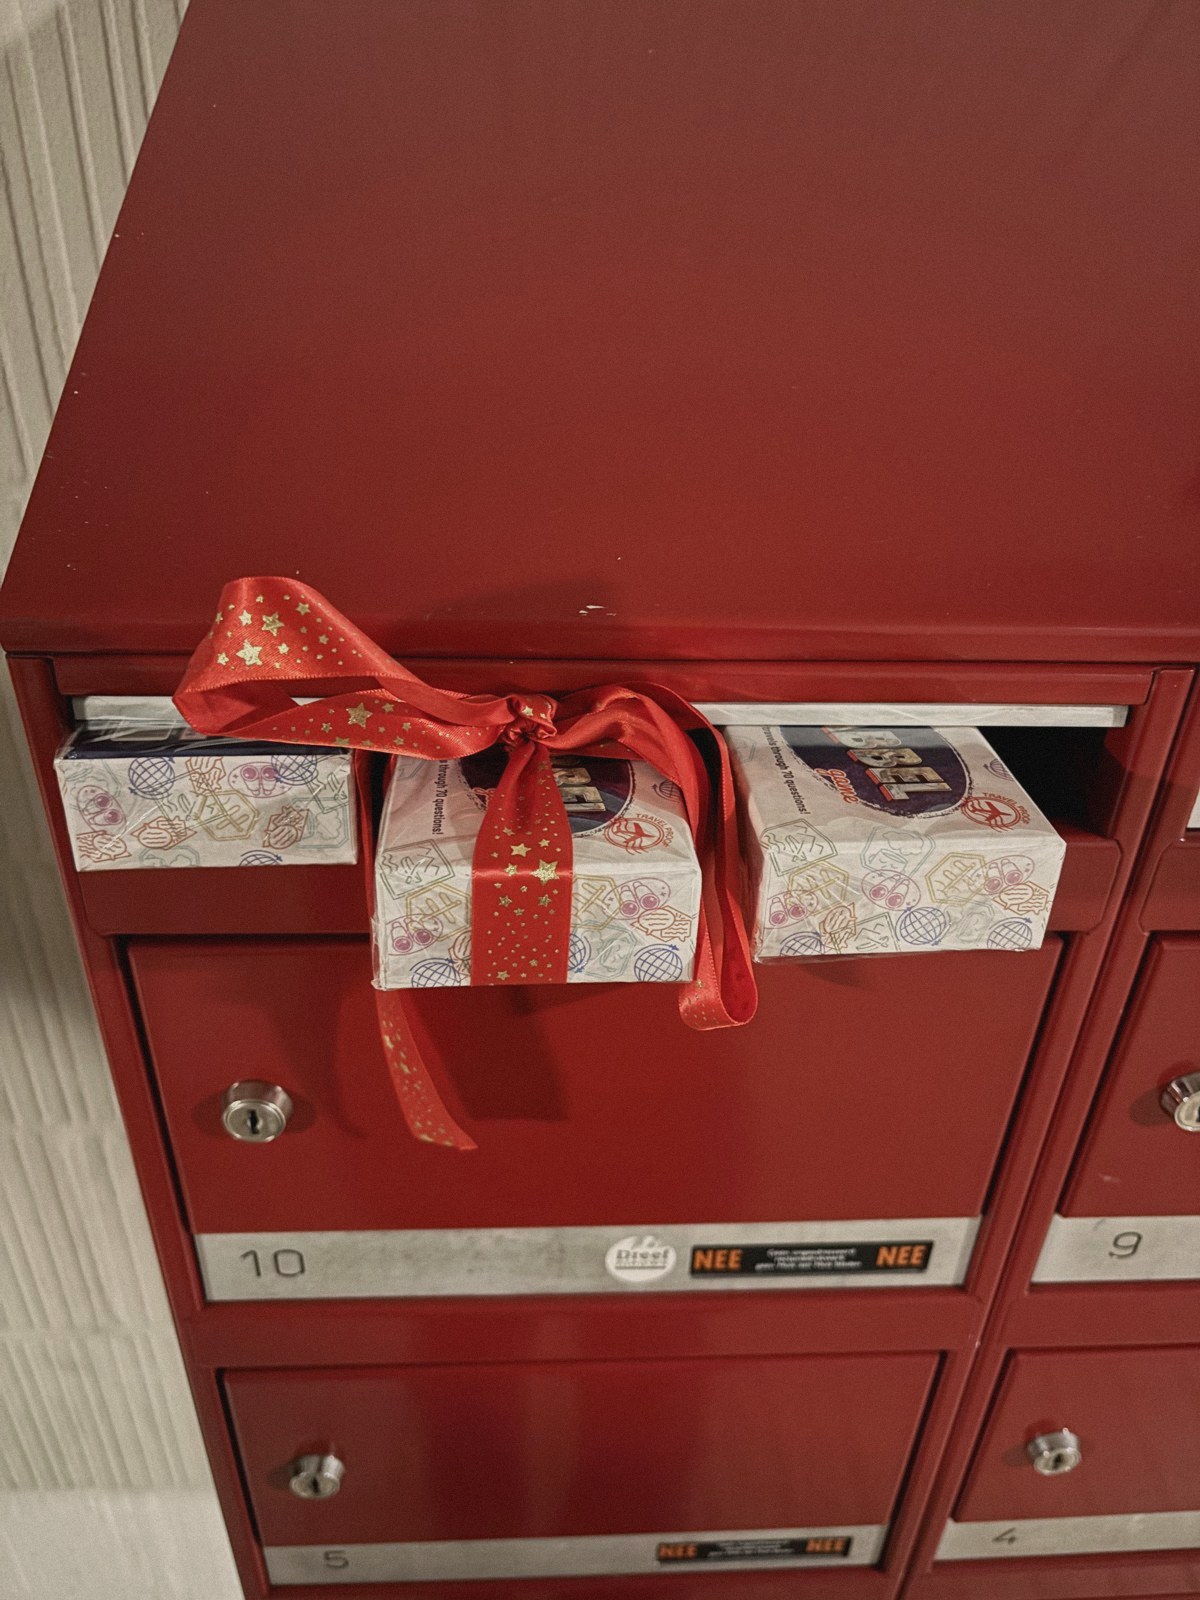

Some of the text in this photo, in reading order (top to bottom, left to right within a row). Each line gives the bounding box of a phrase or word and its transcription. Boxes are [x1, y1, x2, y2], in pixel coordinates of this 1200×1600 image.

[770, 746, 790, 771] through
[822, 725, 952, 801] BBEL
[434, 764, 449, 789] through
[781, 770, 795, 780] 70
[813, 767, 860, 805] game
[436, 789, 448, 798] 70
[783, 777, 811, 815] questions!
[982, 792, 1018, 805] TRAVEL
[432, 798, 446, 835] questions!
[635, 813, 668, 829] TRAVEL
[876, 1244, 928, 1267] NEE
[1108, 1231, 1143, 1259] 9
[240, 1248, 306, 1278] 10
[693, 1248, 743, 1271] NEE
[805, 1537, 847, 1555] NEE
[991, 1527, 1017, 1545] 4
[323, 1550, 350, 1570] 5
[657, 1543, 698, 1561] NEE
